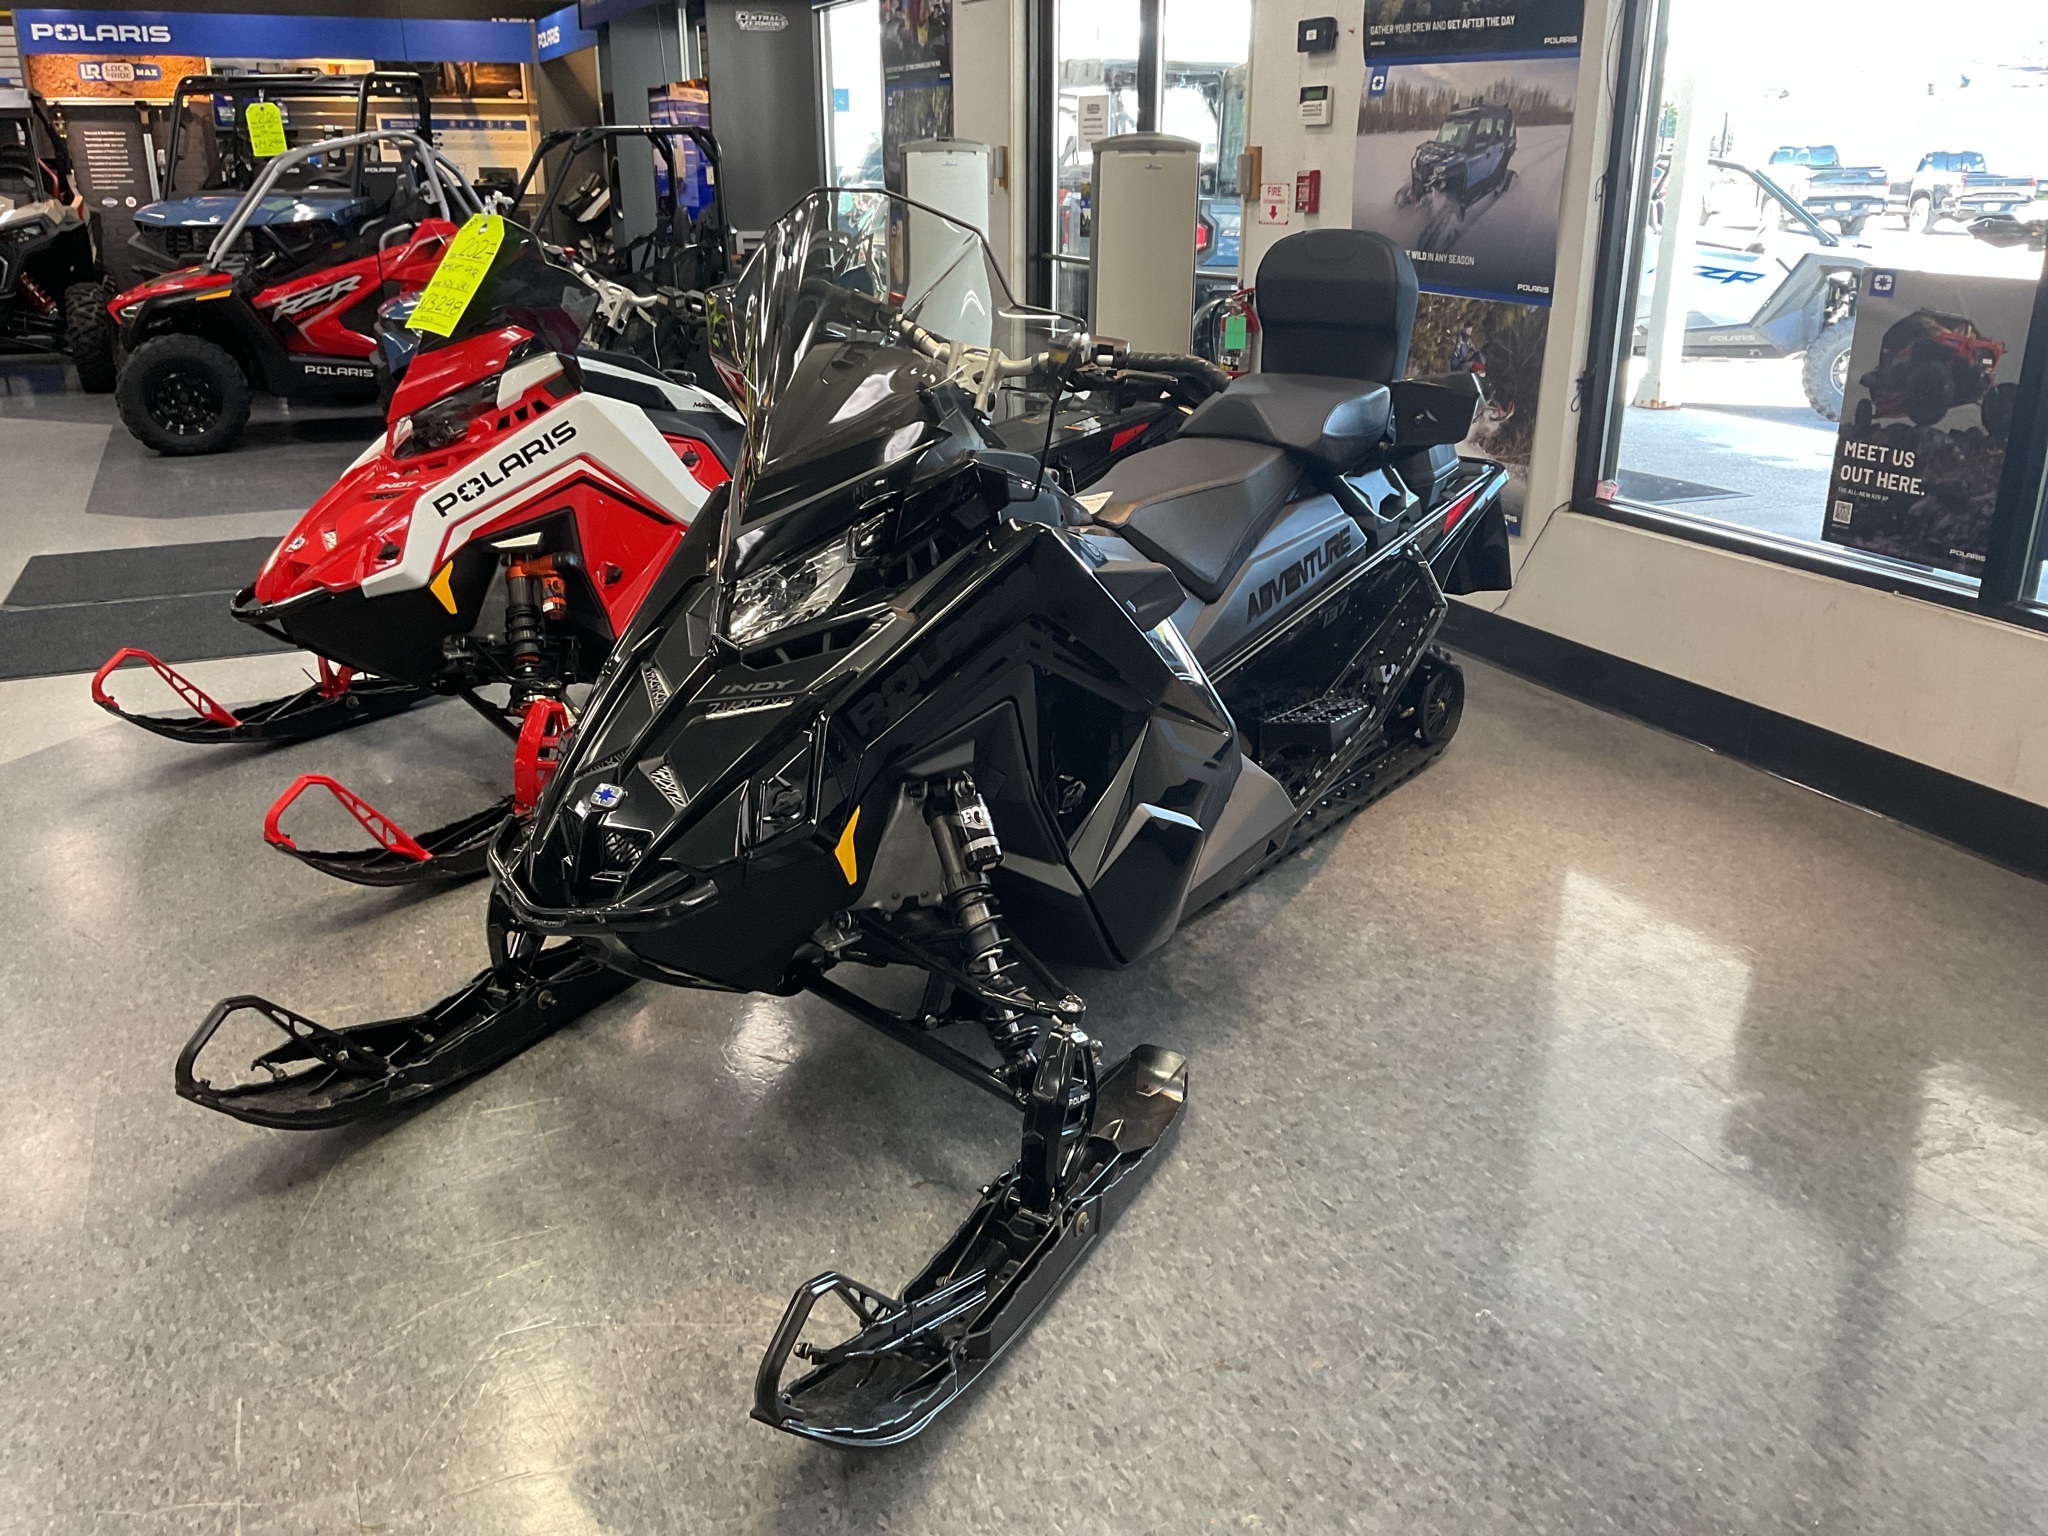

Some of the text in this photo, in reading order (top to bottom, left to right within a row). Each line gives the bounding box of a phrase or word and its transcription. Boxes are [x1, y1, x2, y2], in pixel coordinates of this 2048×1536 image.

[30, 23, 172, 43] POLARIS
[1370, 15, 1516, 36] GATHER YOUR CREW AND GET AFTER THE DAY
[537, 26, 560, 49] POLARIS
[1544, 36, 1578, 45] POLARIS
[135, 68, 158, 77] MAX
[1267, 186, 1282, 197] FIRE
[1411, 251, 1427, 261] WILD
[1427, 252, 1434, 262] IN
[1434, 253, 1448, 263] ANY
[1448, 254, 1475, 266] SEASON
[1517, 283, 1550, 294] POLARIS
[271, 275, 363, 322] RZR
[1708, 334, 1756, 342] POLARIS
[304, 365, 374, 378] POLARIS
[1844, 440, 1916, 468] MEET US
[432, 420, 577, 518] POLARIS
[375, 480, 419, 490] INDY
[1840, 465, 1926, 496] OUT HERE.
[1838, 486, 1847, 494] THE
[1949, 548, 1987, 562] POLARIS
[1247, 524, 1352, 626] ADVENTURE
[719, 679, 796, 694] INDY
